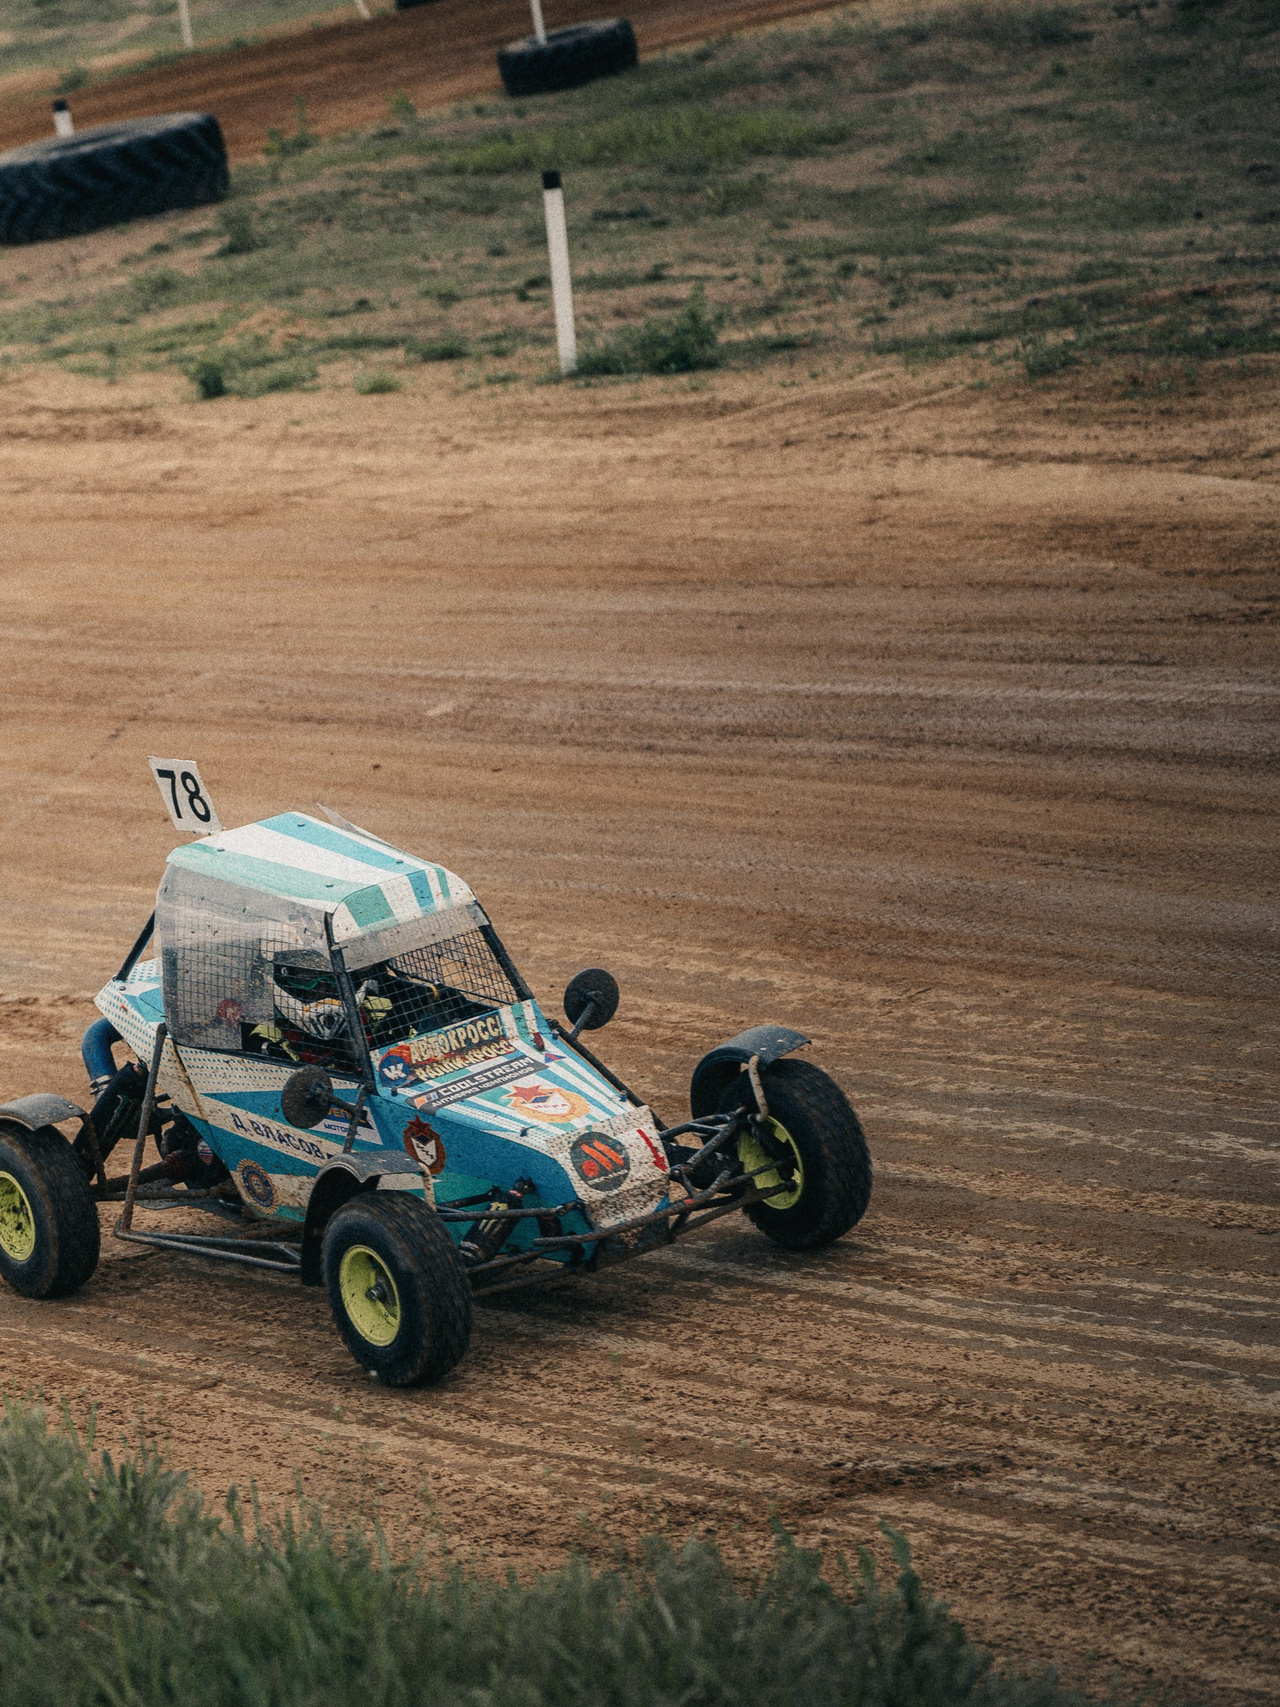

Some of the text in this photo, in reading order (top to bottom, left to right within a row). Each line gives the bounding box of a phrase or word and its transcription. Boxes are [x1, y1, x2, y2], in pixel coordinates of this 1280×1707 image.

[156, 768, 211, 823] 78
[437, 1057, 535, 1096] COOLSTREAM
[247, 1119, 326, 1160] ВЛАСОВ
